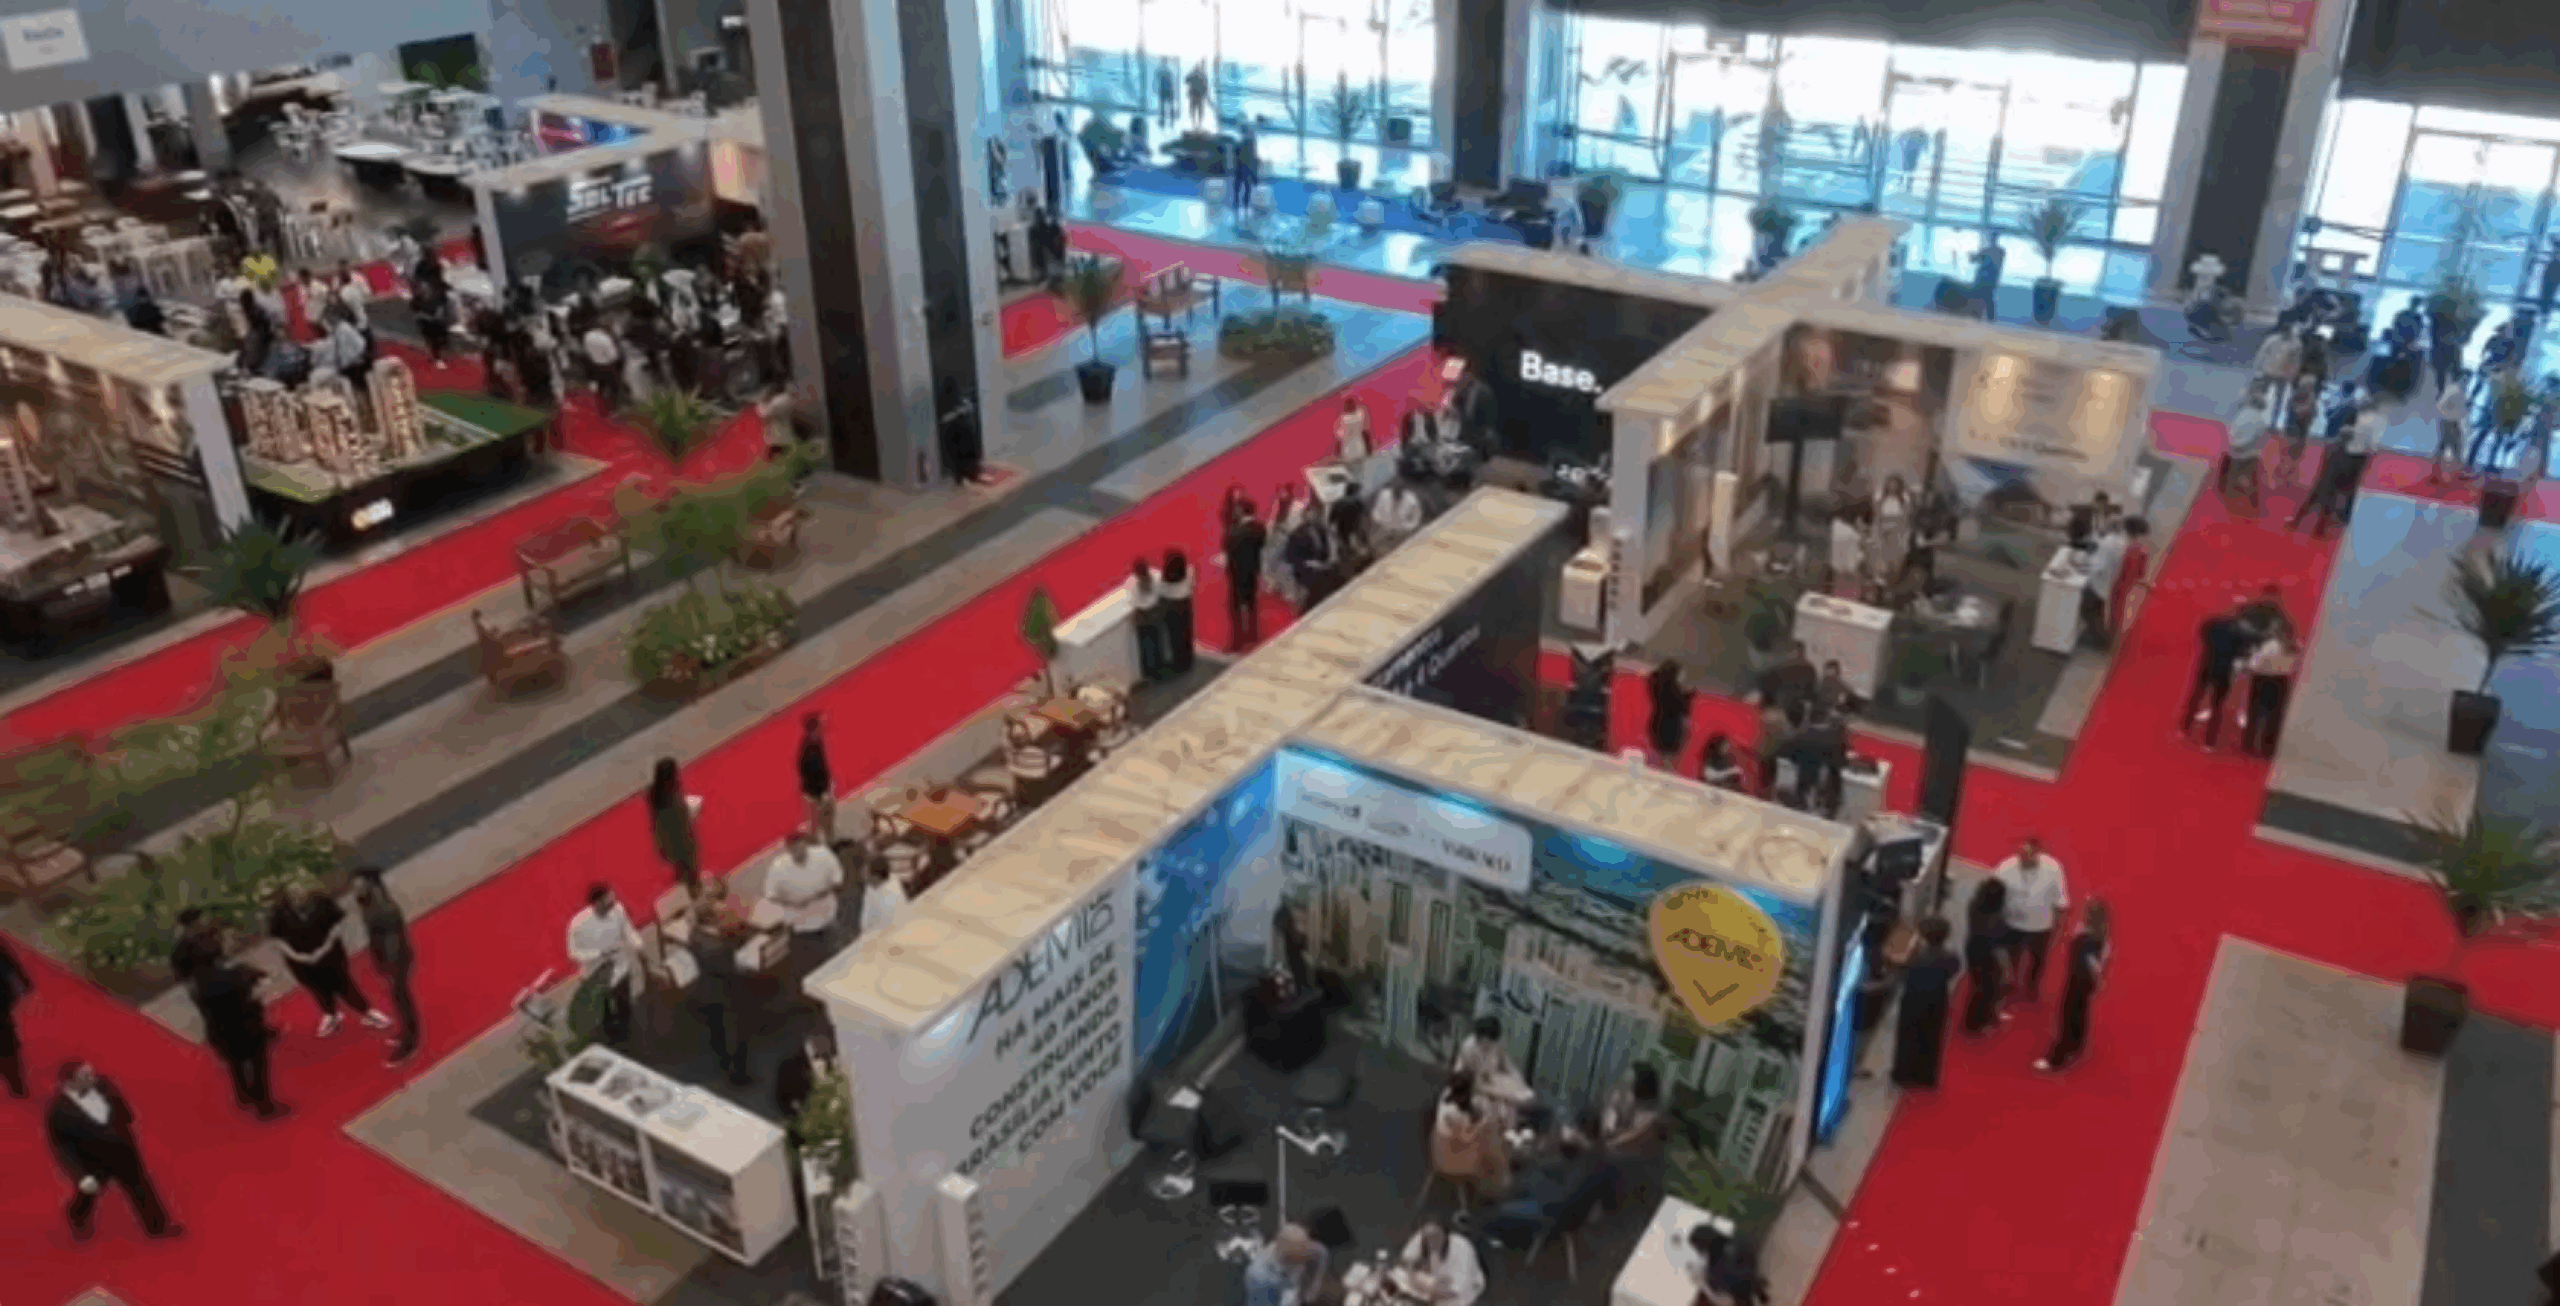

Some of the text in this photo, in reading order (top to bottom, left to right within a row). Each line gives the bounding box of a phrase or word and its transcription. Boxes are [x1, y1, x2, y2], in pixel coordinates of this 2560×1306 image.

[1032, 965, 1085, 1026] MAIS
[1088, 941, 1116, 977] DE
[1063, 967, 1117, 1029] ANOS
[969, 995, 1119, 1141] CONSTRUINDO
[1018, 1100, 1065, 1152] COM
